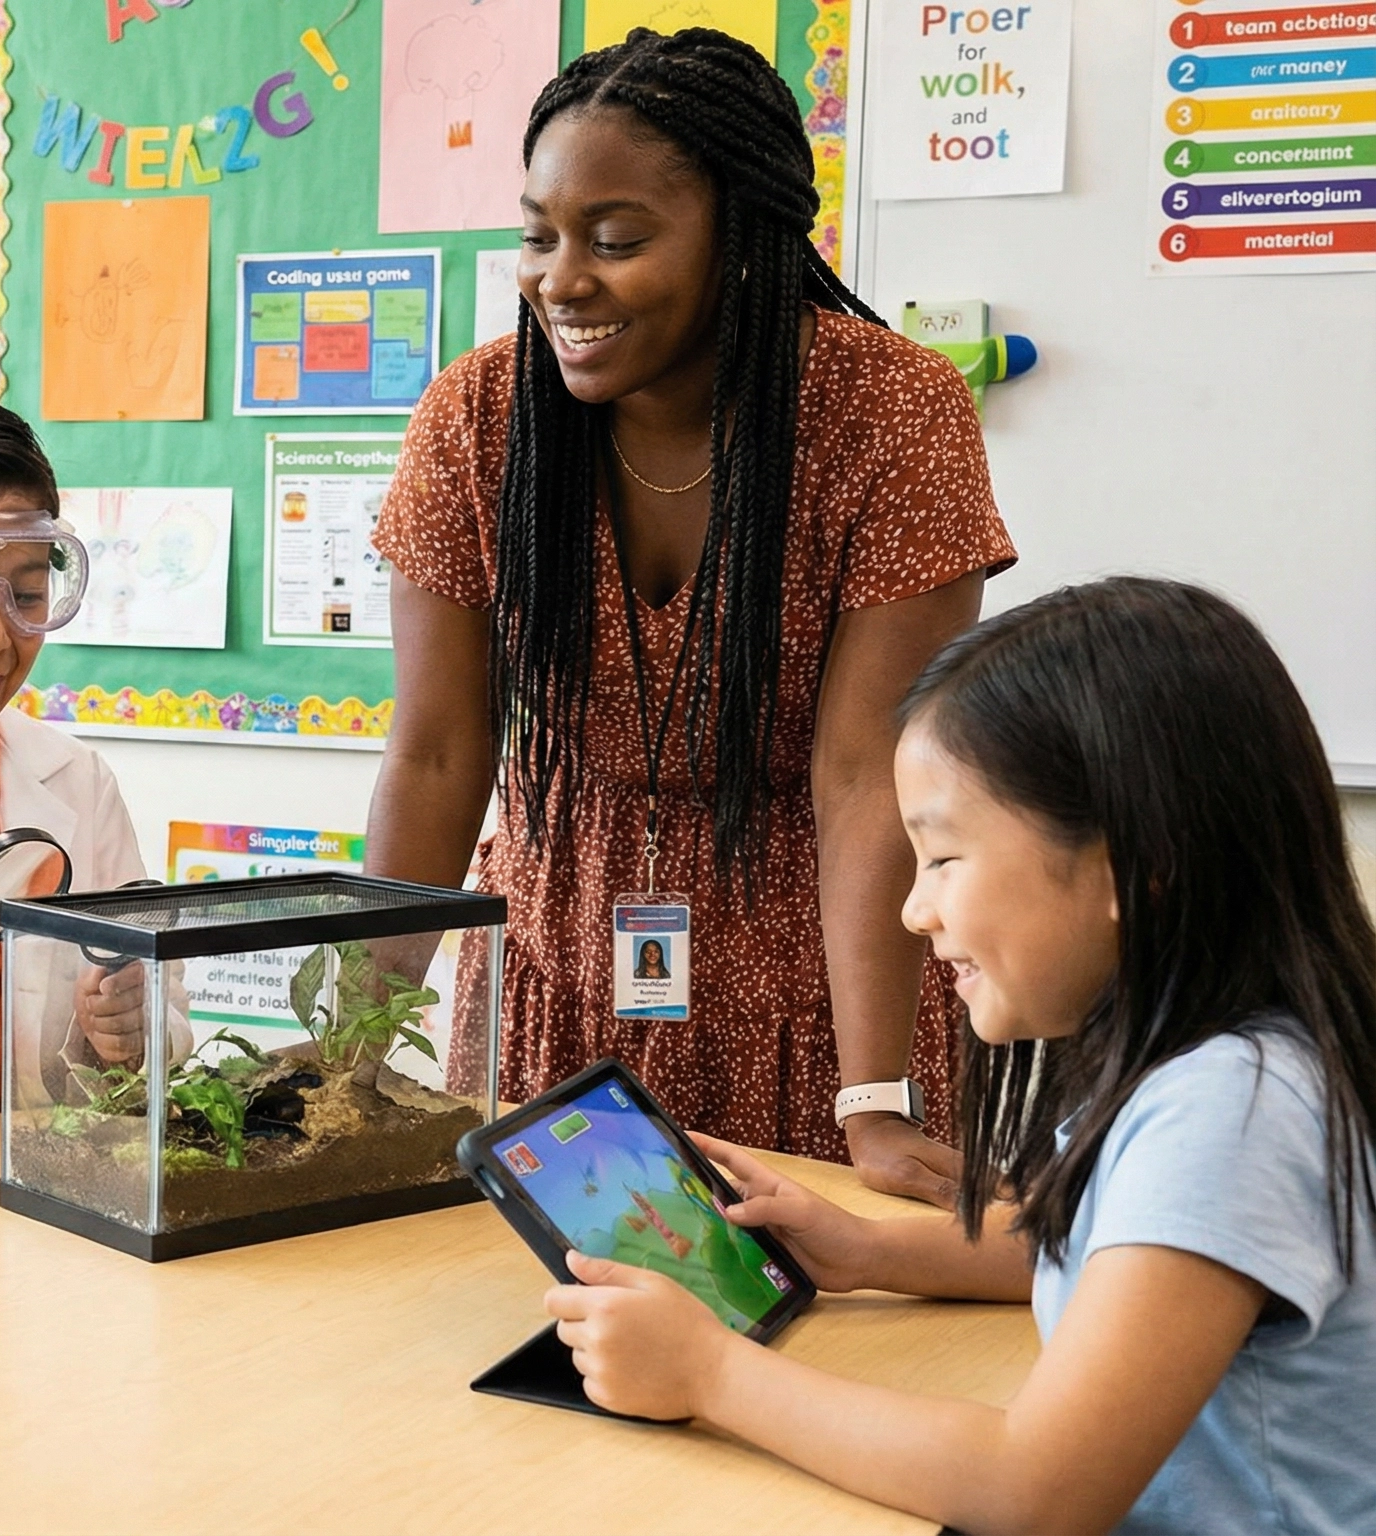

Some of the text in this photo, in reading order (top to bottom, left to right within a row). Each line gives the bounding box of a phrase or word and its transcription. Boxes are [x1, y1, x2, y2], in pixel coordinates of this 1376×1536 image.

[922, 5, 1031, 36] Proer
[1182, 20, 1193, 41] 1
[1226, 20, 1277, 36] team
[958, 44, 987, 61] for
[1178, 62, 1195, 84] 2
[951, 107, 988, 125] and
[1176, 105, 1192, 126] 3
[929, 128, 1010, 161] toot
[1174, 147, 1191, 168] 4
[1172, 190, 1189, 211] 5
[1169, 233, 1186, 254] 6
[267, 269, 322, 287] Coding
[366, 269, 411, 285] game
[276, 451, 333, 465] Science
[238, 995, 253, 1006] of
